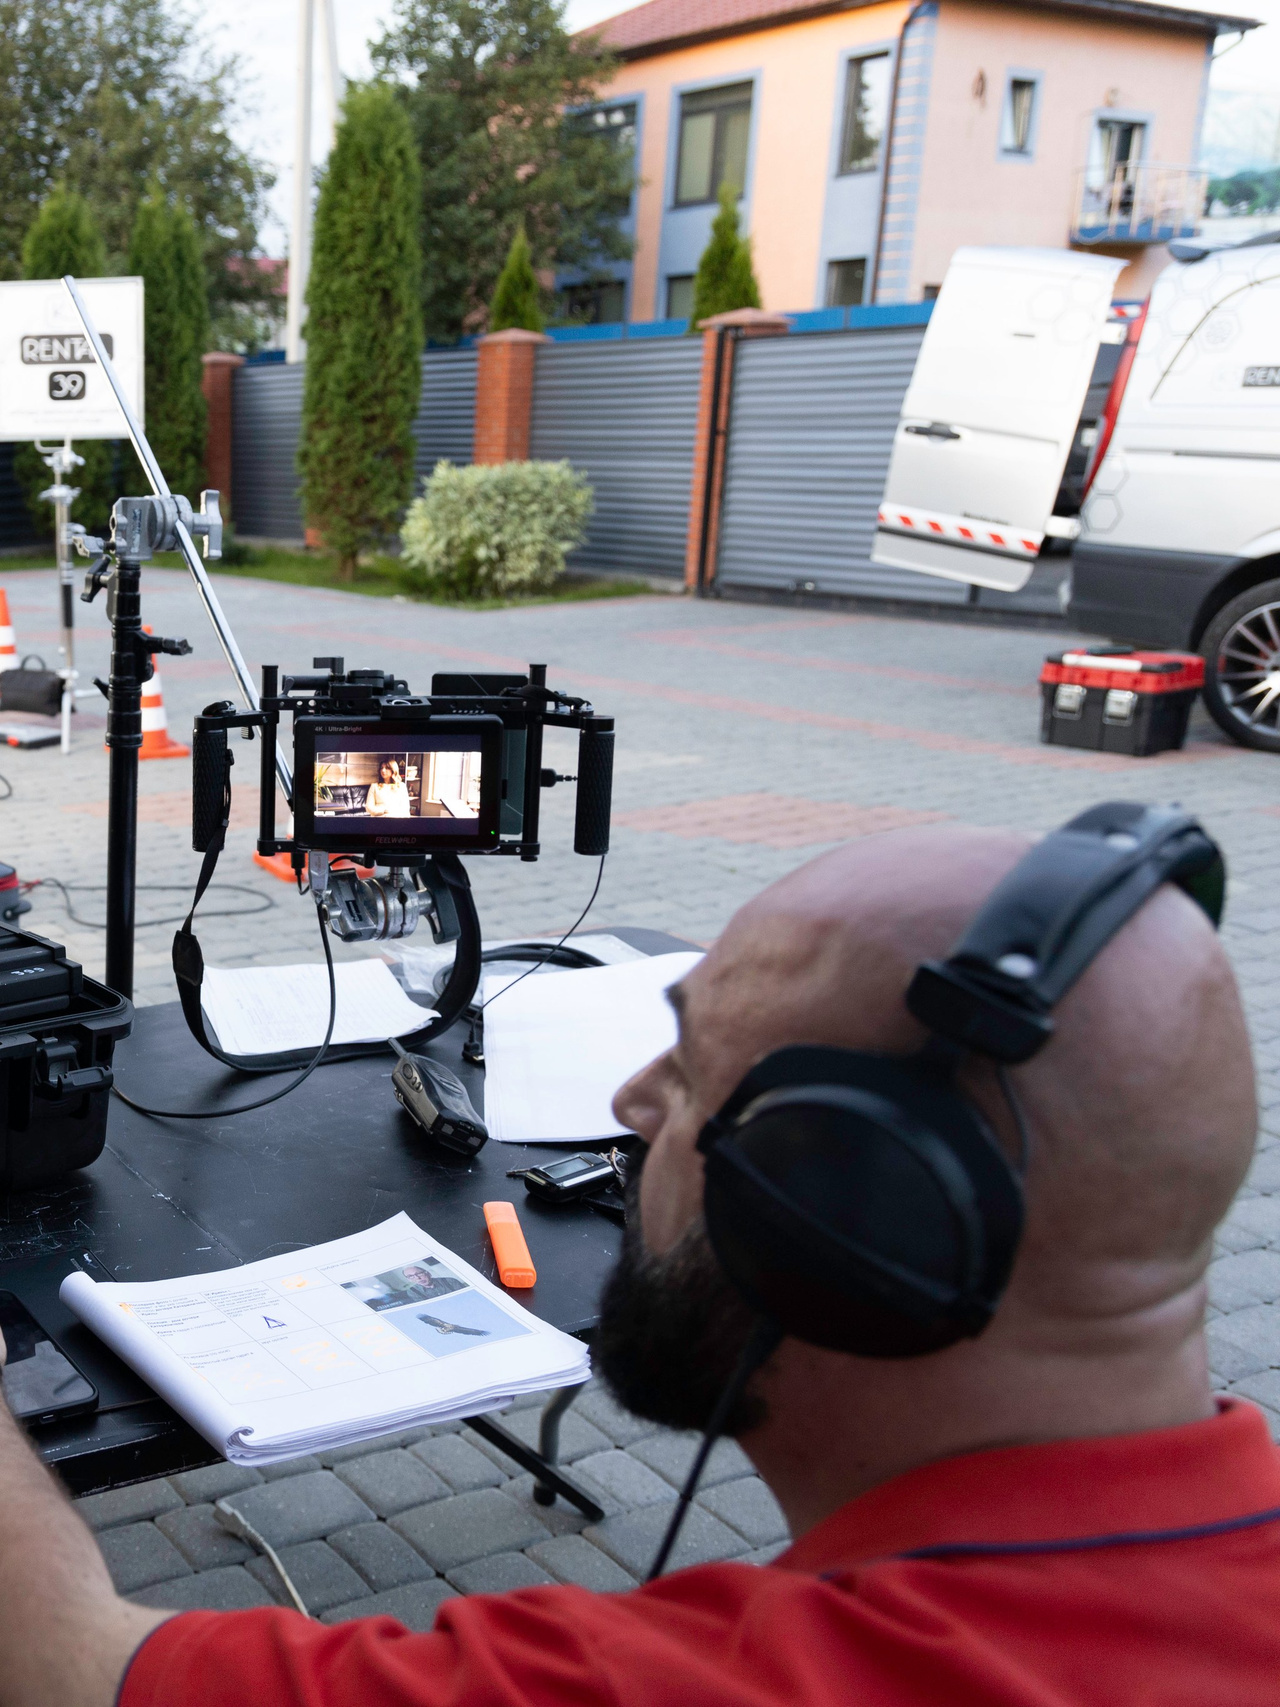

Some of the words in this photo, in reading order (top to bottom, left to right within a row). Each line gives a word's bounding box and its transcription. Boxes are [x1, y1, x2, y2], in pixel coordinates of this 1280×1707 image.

[23, 338, 109, 362] RENTA
[51, 374, 84, 398] 39
[11, 967, 45, 976] 399
